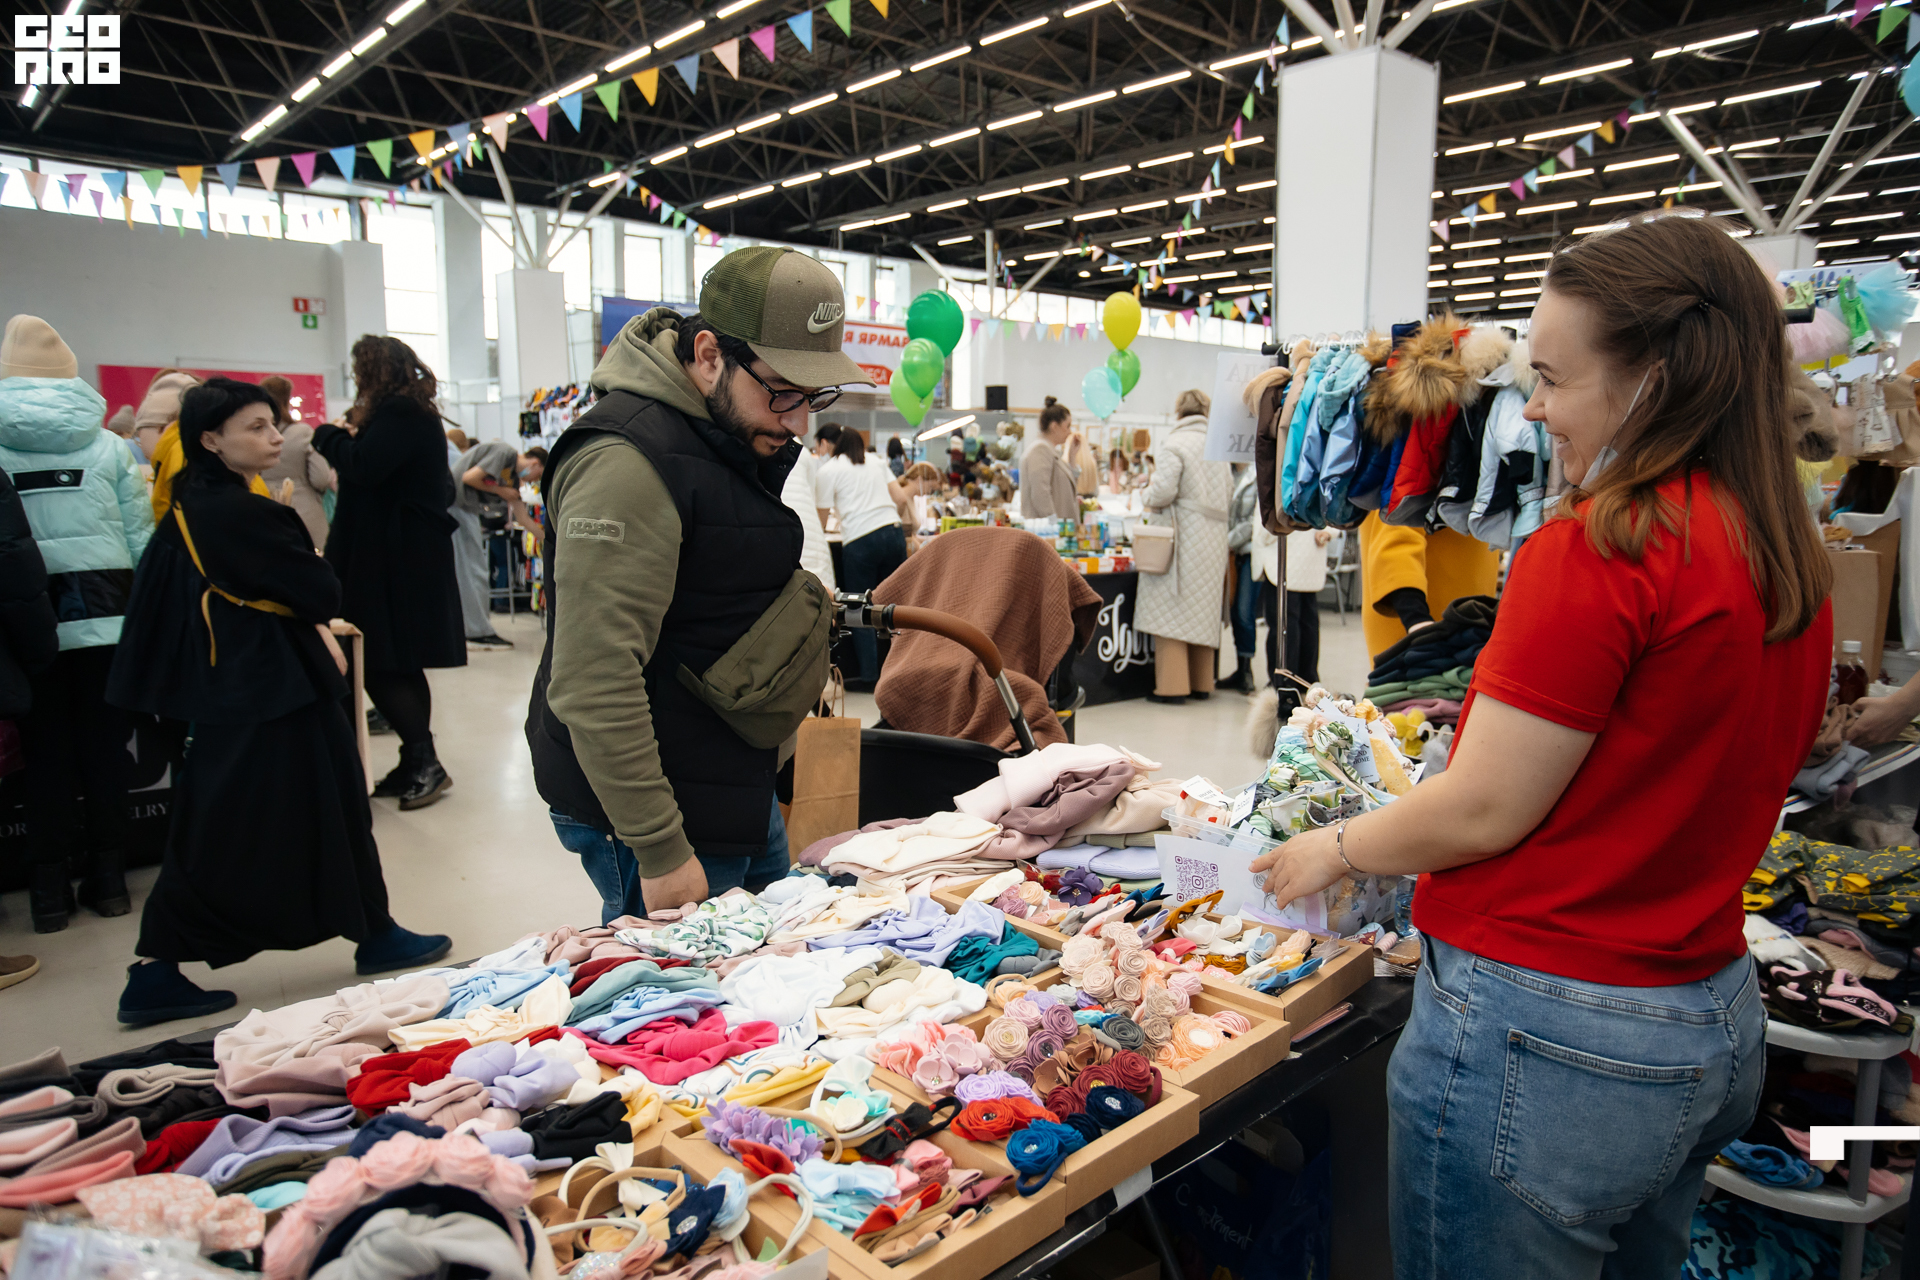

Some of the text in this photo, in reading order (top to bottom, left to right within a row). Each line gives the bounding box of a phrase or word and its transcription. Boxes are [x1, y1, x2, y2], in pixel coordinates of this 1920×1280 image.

[814, 302, 841, 321] NIKE
[843, 330, 910, 348] Я ЯРМАР
[569, 520, 621, 538] HARD
